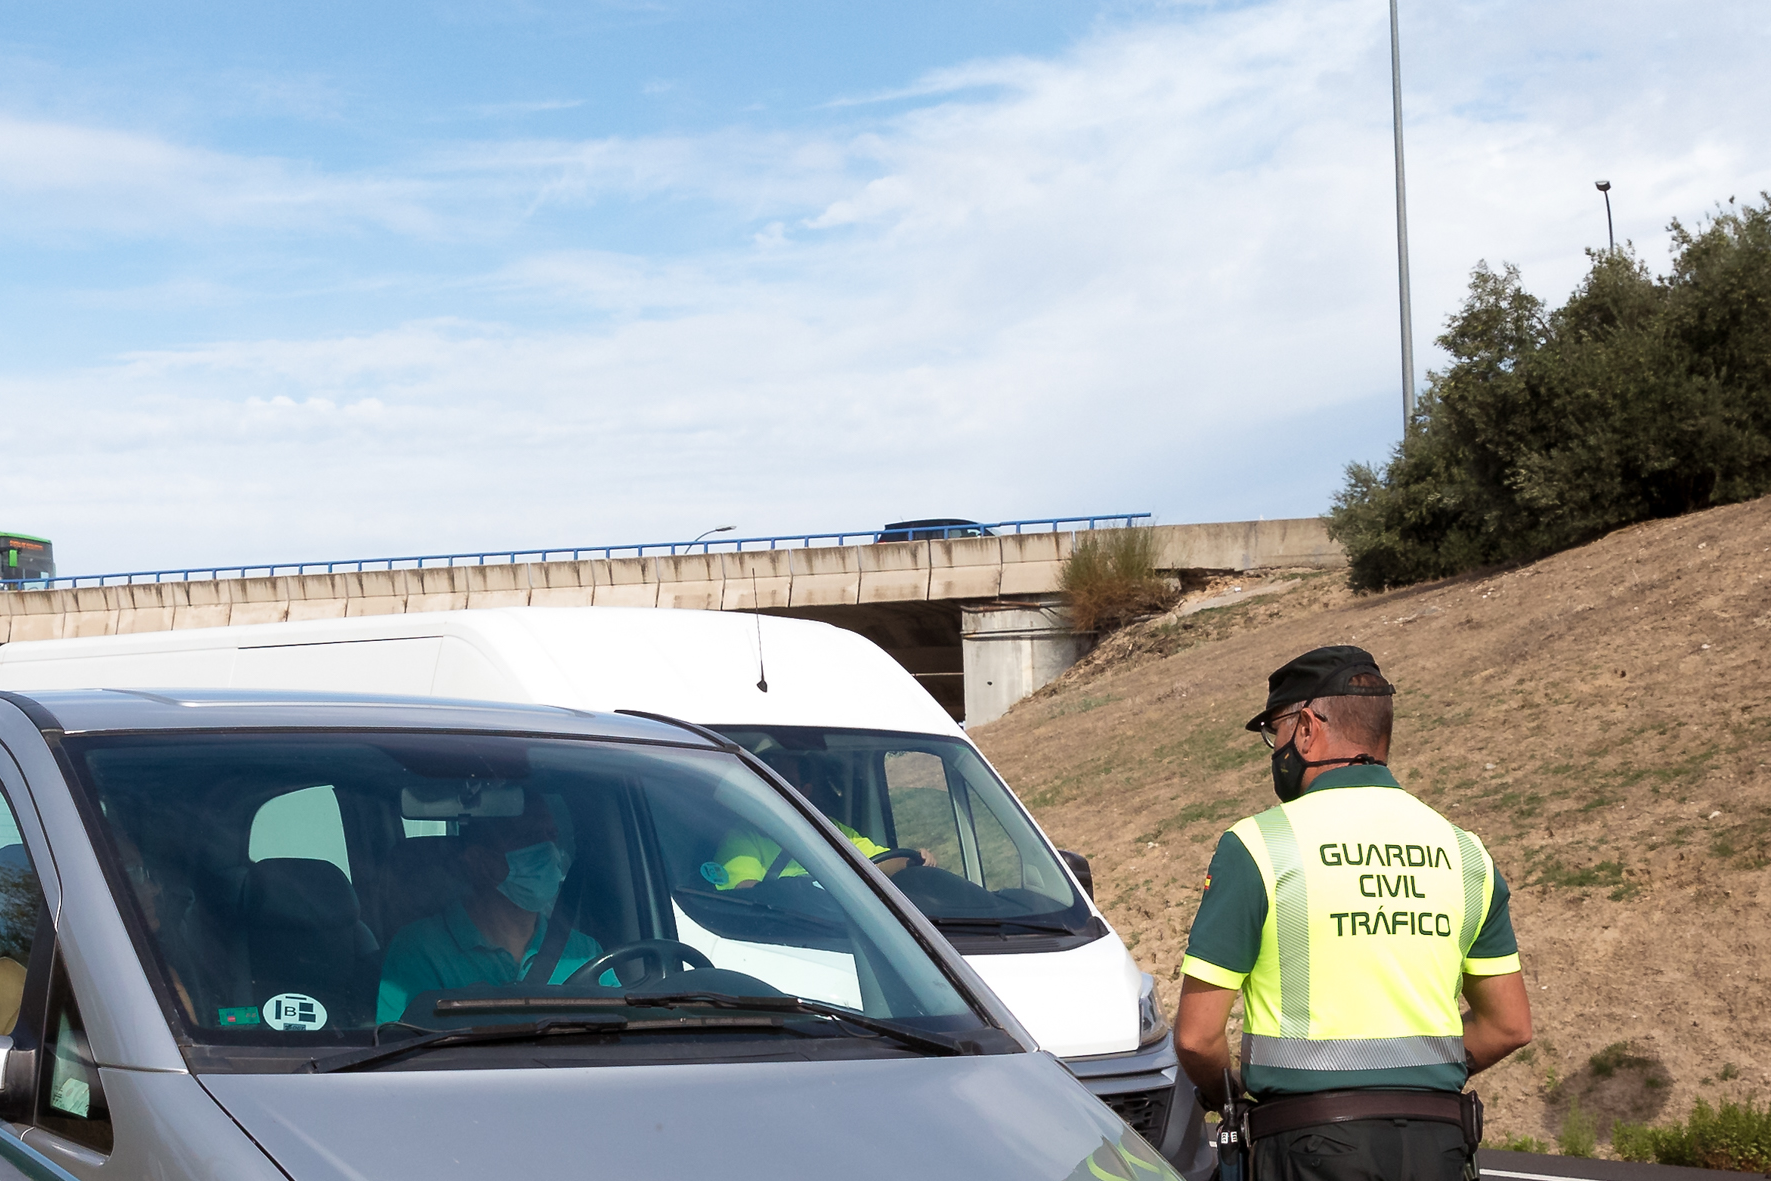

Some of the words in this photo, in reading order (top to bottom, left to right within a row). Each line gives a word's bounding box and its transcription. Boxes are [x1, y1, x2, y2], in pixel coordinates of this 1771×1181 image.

[1319, 843, 1452, 870] GUARDIA
[1359, 874, 1426, 899] CIVIL
[1329, 905, 1451, 937] TRÁFICO
[284, 1006, 297, 1017] B
